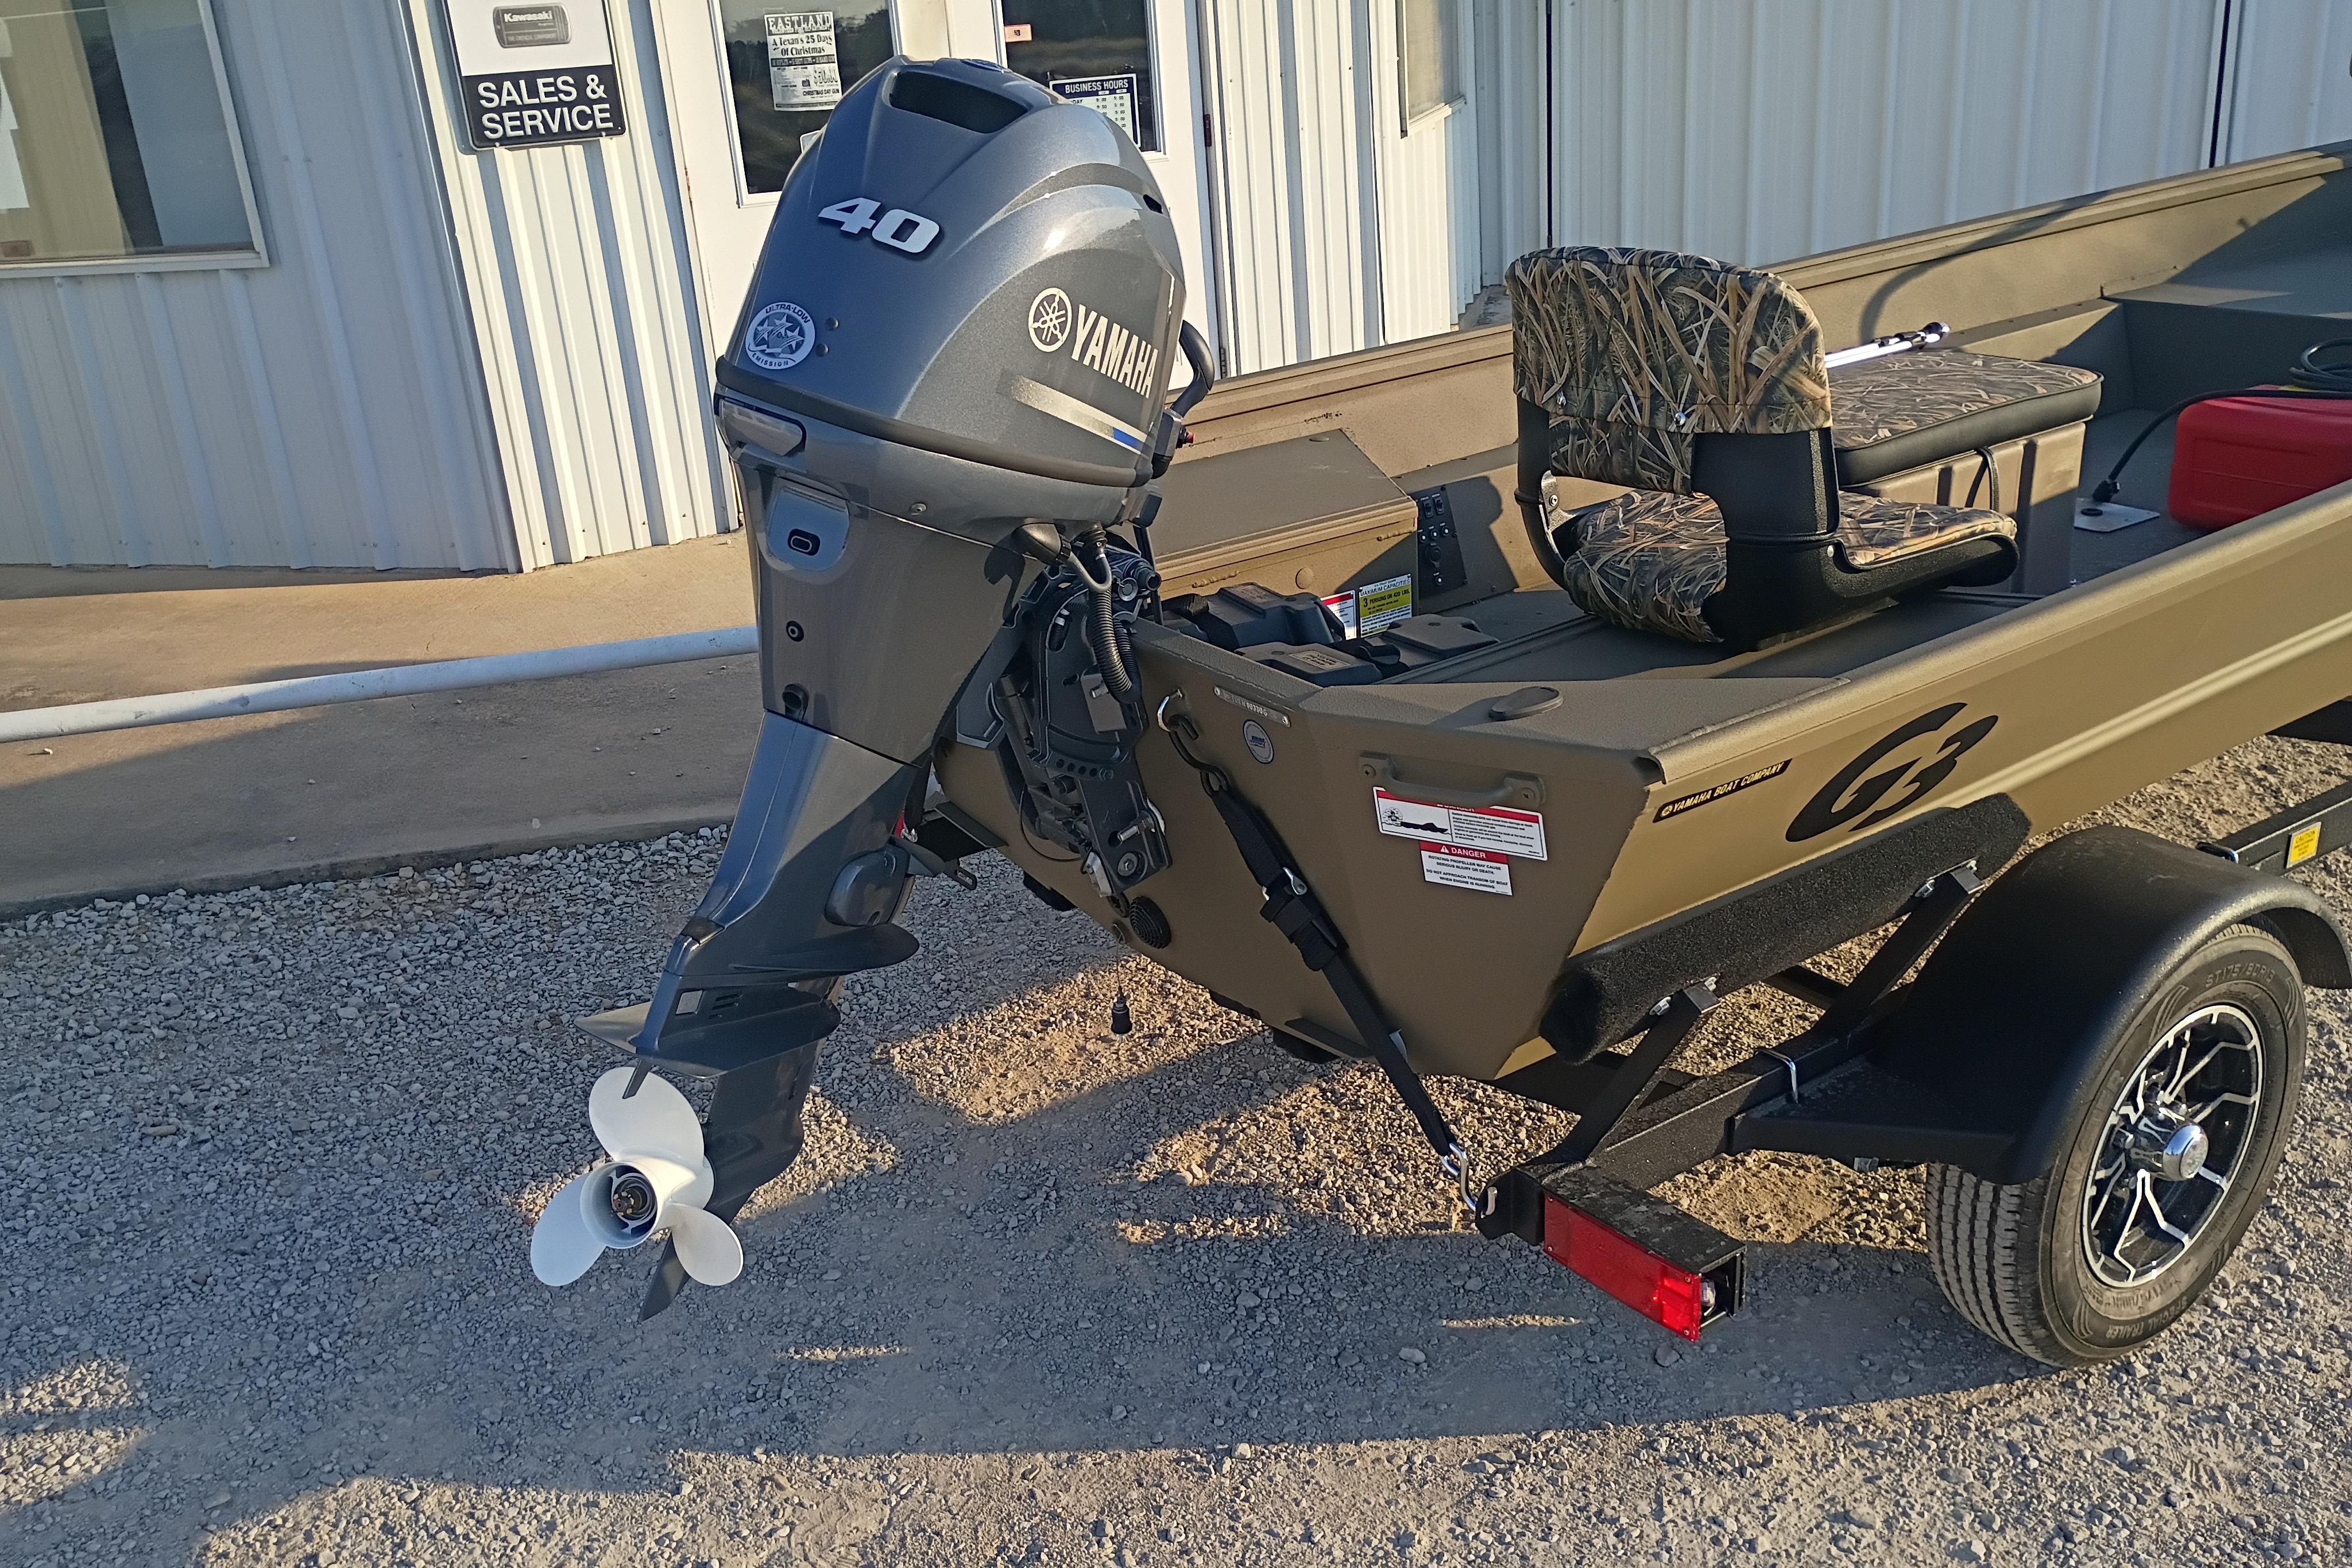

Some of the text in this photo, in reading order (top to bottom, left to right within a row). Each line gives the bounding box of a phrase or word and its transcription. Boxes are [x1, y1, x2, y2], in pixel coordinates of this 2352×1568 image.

[504, 10, 553, 22] Kawasaki
[768, 14, 831, 29] EASTLAND
[772, 34, 833, 46] A Texan's 25 Days
[781, 46, 825, 56] Of Christmas
[478, 74, 608, 109] SALES &
[1065, 79, 1128, 94] BUSINESS HOURS
[482, 103, 613, 140] SERVICE
[818, 197, 939, 253] 40
[1071, 304, 1158, 398] YAMAHA
[752, 353, 788, 367] EMISSION
[1360, 579, 1410, 597] MAXIMUM CAPACITIES
[1363, 598, 1368, 607] 3
[1370, 595, 1387, 605] PERSONS
[1785, 702, 1998, 842] G3
[1673, 762, 1785, 812] YAMAHA BOAT COMPANY
[1451, 847, 1486, 859] DANGER
[1450, 858, 1476, 866] PROPELLER
[2205, 962, 2275, 988] ST175/80R13
[2106, 1322, 2144, 1339] TRAILER
